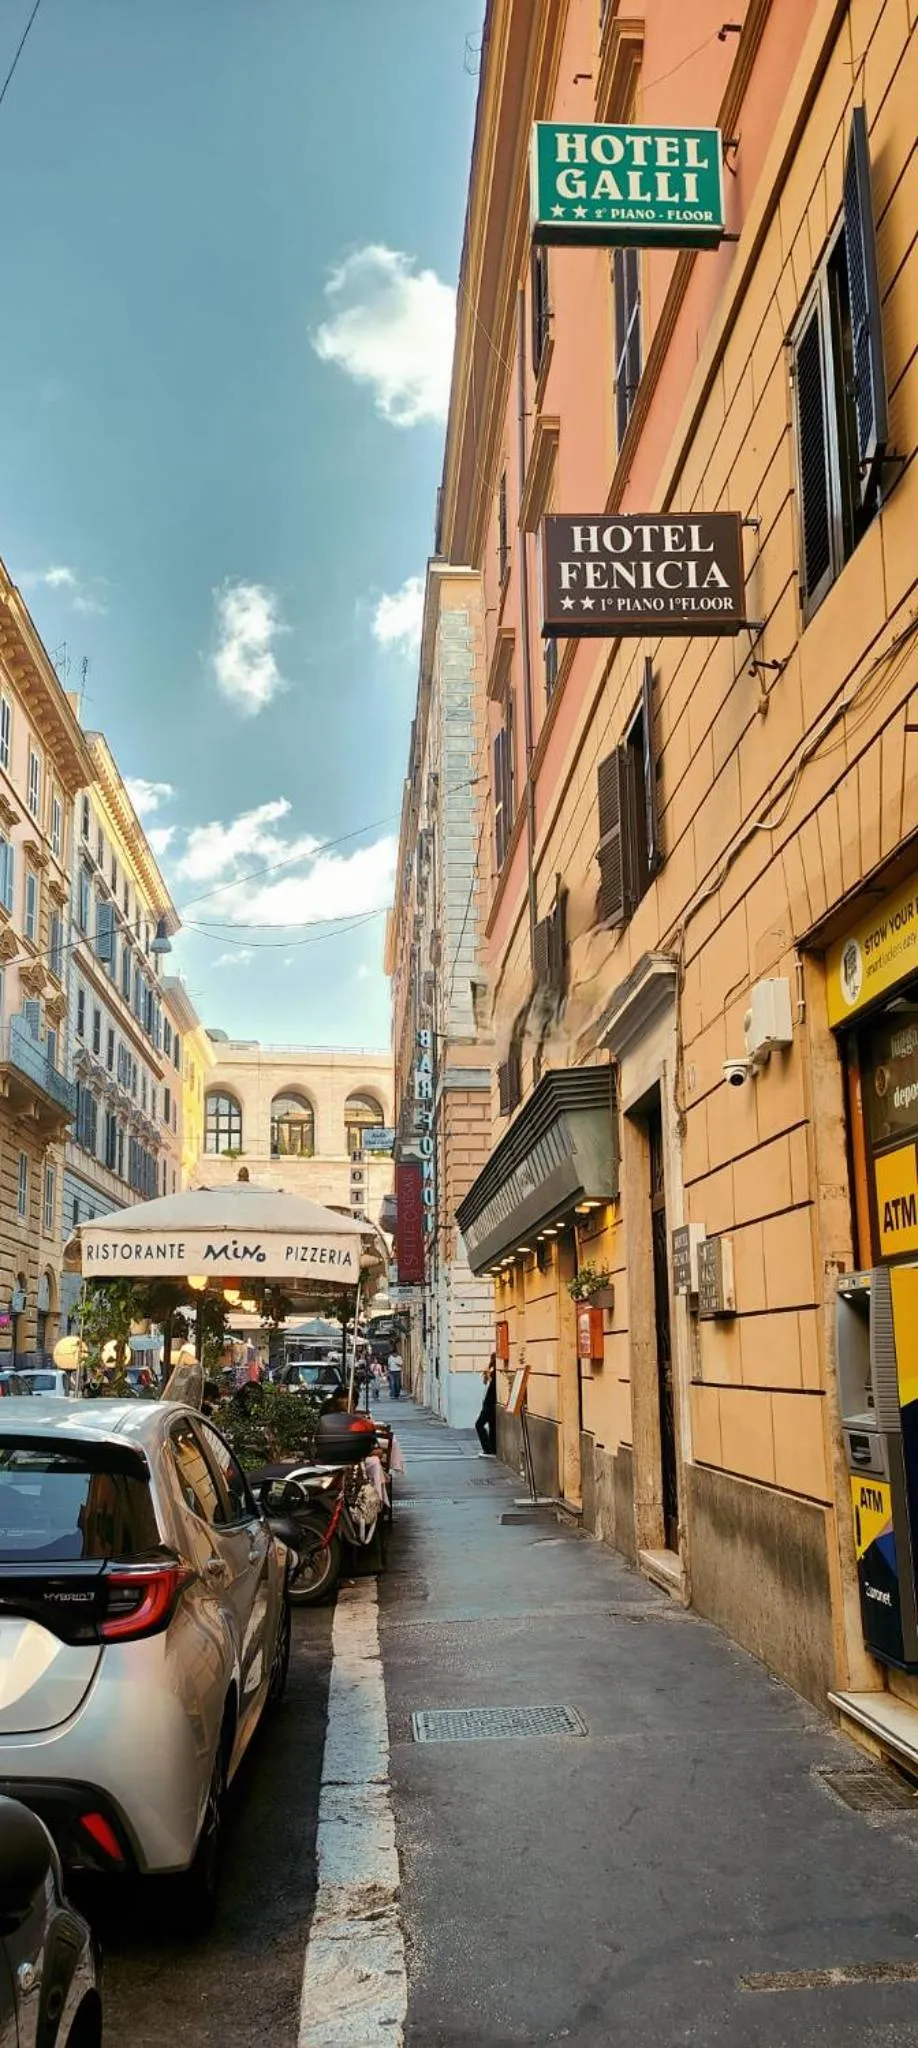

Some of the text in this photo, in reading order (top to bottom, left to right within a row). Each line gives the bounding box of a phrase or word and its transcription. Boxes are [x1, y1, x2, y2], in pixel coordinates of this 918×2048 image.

[554, 133, 709, 169] HOTEL
[555, 168, 700, 204] GALLI
[611, 208, 657, 220] PIANO
[667, 210, 714, 222] FLOOR
[570, 525, 715, 553] HOTEL
[558, 560, 731, 590] FENICIA
[617, 597, 665, 611] PIANO
[864, 921, 888, 955] STOW
[888, 902, 914, 935] YOUR
[883, 1193, 917, 1233] ATM
[86, 1243, 185, 1261] RISTORANTE
[286, 1246, 352, 1266] PIZZERIA
[860, 1486, 884, 1513] ATM
